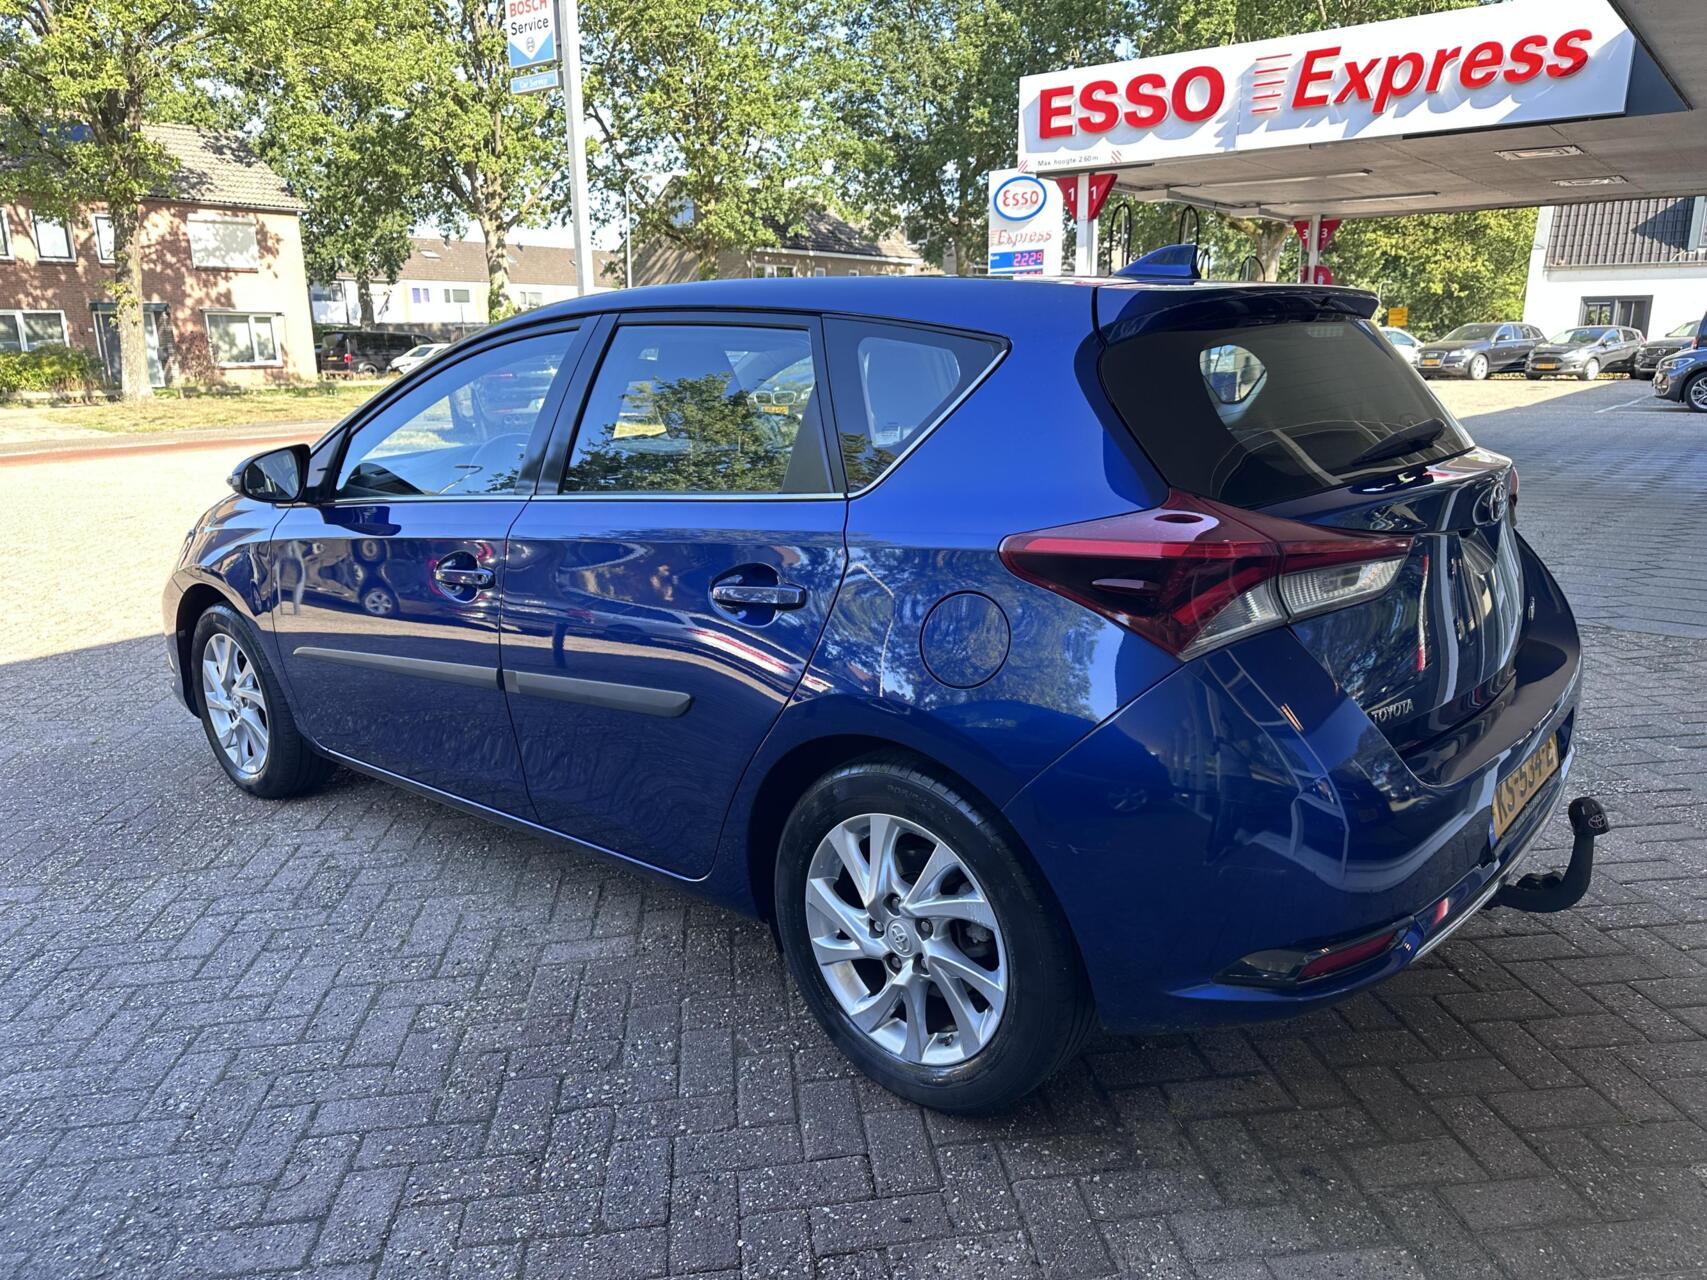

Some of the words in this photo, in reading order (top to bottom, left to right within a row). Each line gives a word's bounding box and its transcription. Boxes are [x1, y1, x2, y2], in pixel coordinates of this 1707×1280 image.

[509, 0, 547, 17] BOSCH
[510, 17, 549, 36] Service
[1039, 66, 1226, 139] ESSO
[1292, 28, 1593, 113] Express
[1068, 187, 1075, 202] 1
[1090, 185, 1097, 200] 1
[998, 229, 1052, 247] Express
[1321, 228, 1328, 238] 3
[1370, 698, 1414, 724] TOYOTA
